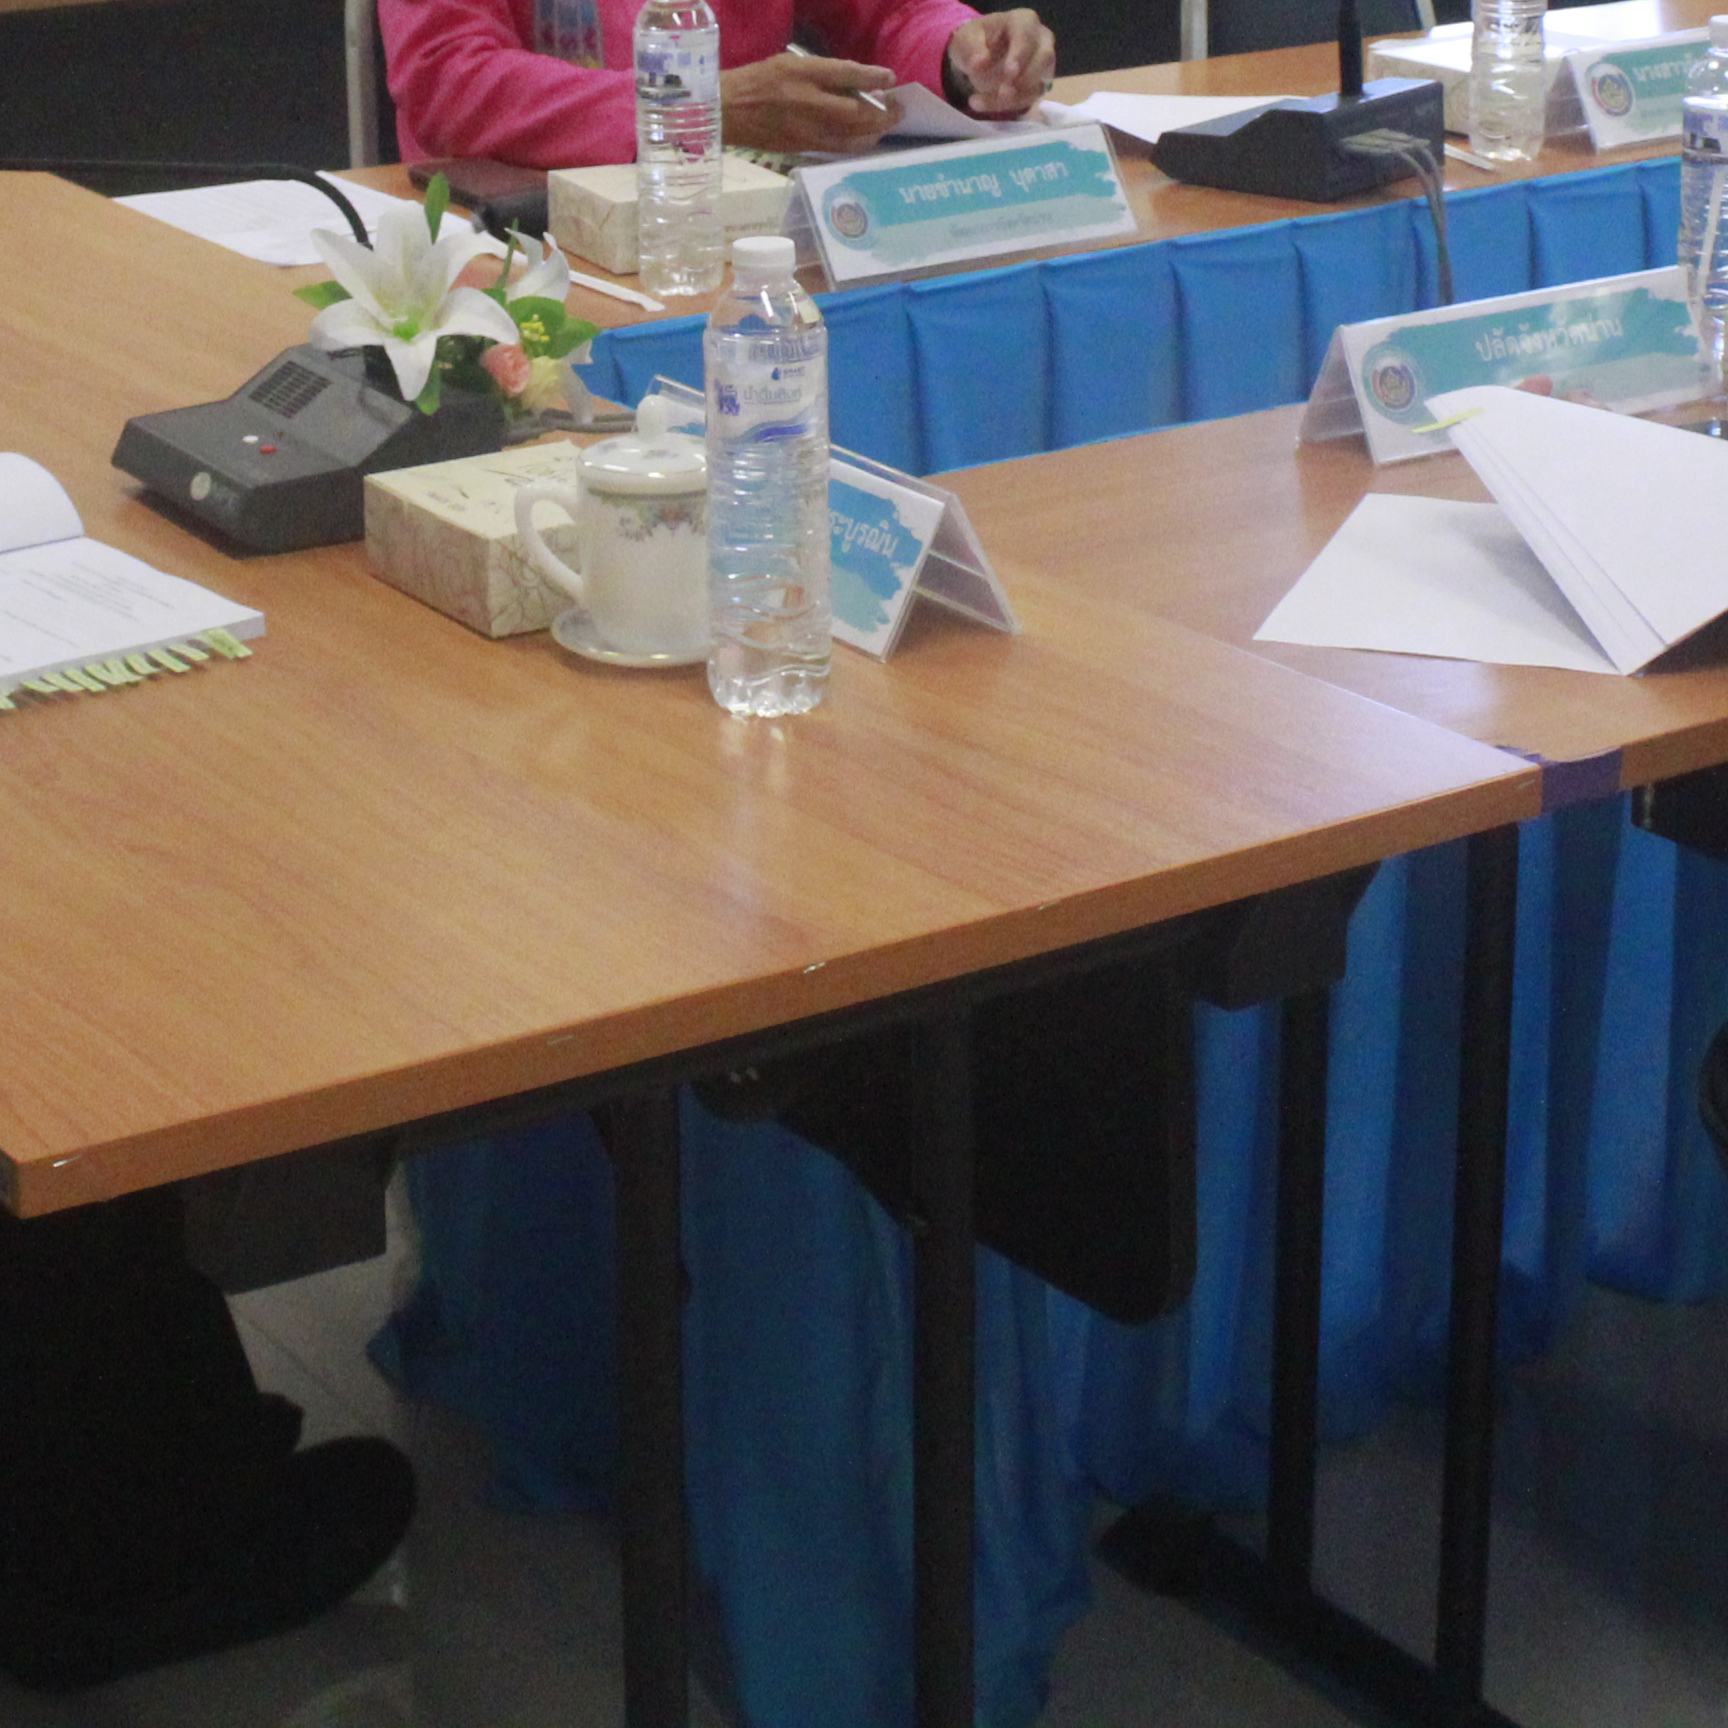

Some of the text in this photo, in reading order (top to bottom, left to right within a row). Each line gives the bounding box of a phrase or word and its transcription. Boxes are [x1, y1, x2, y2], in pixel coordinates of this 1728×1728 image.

[1475, 312, 1624, 363] ปลัดจังหวัดน่าน
